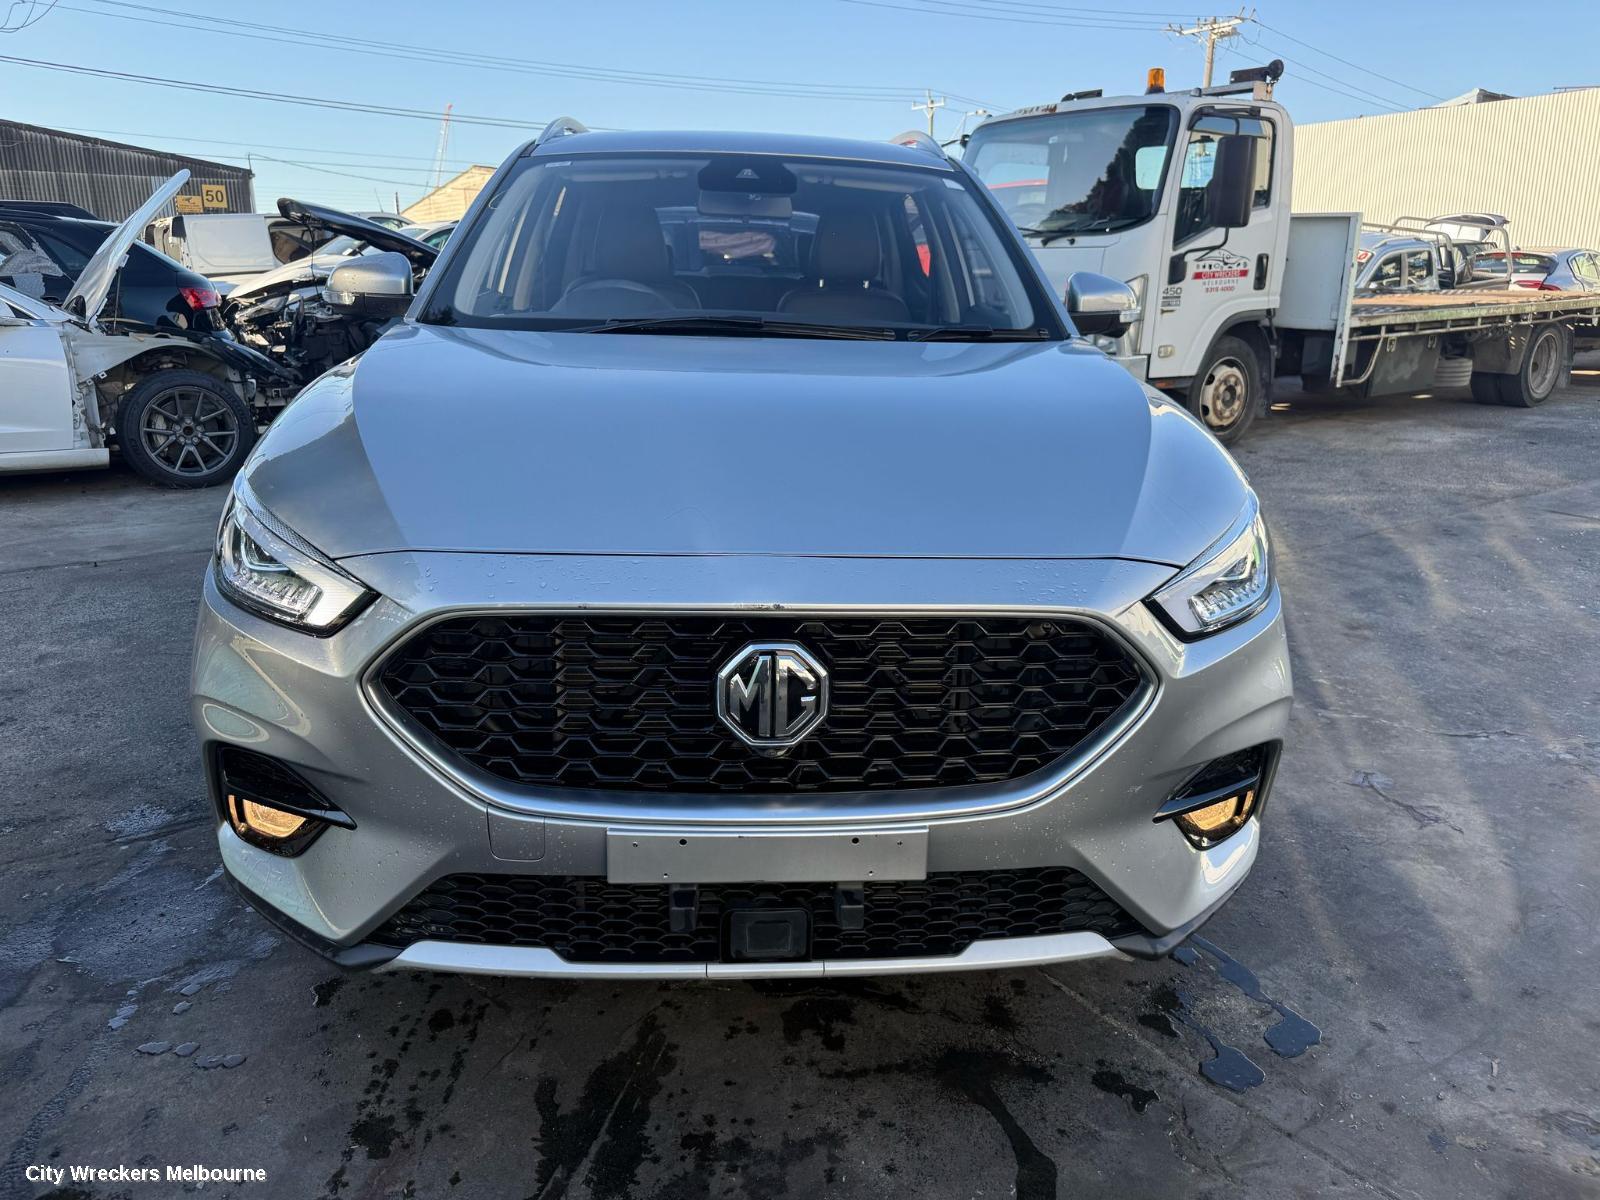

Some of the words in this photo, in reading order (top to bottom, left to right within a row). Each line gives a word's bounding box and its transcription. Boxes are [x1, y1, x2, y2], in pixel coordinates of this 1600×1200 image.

[205, 189, 224, 203] 50
[1201, 271, 1214, 279] CITY
[1214, 269, 1240, 278] WRECKERS
[1162, 287, 1182, 296] 450
[729, 655, 816, 737] MG
